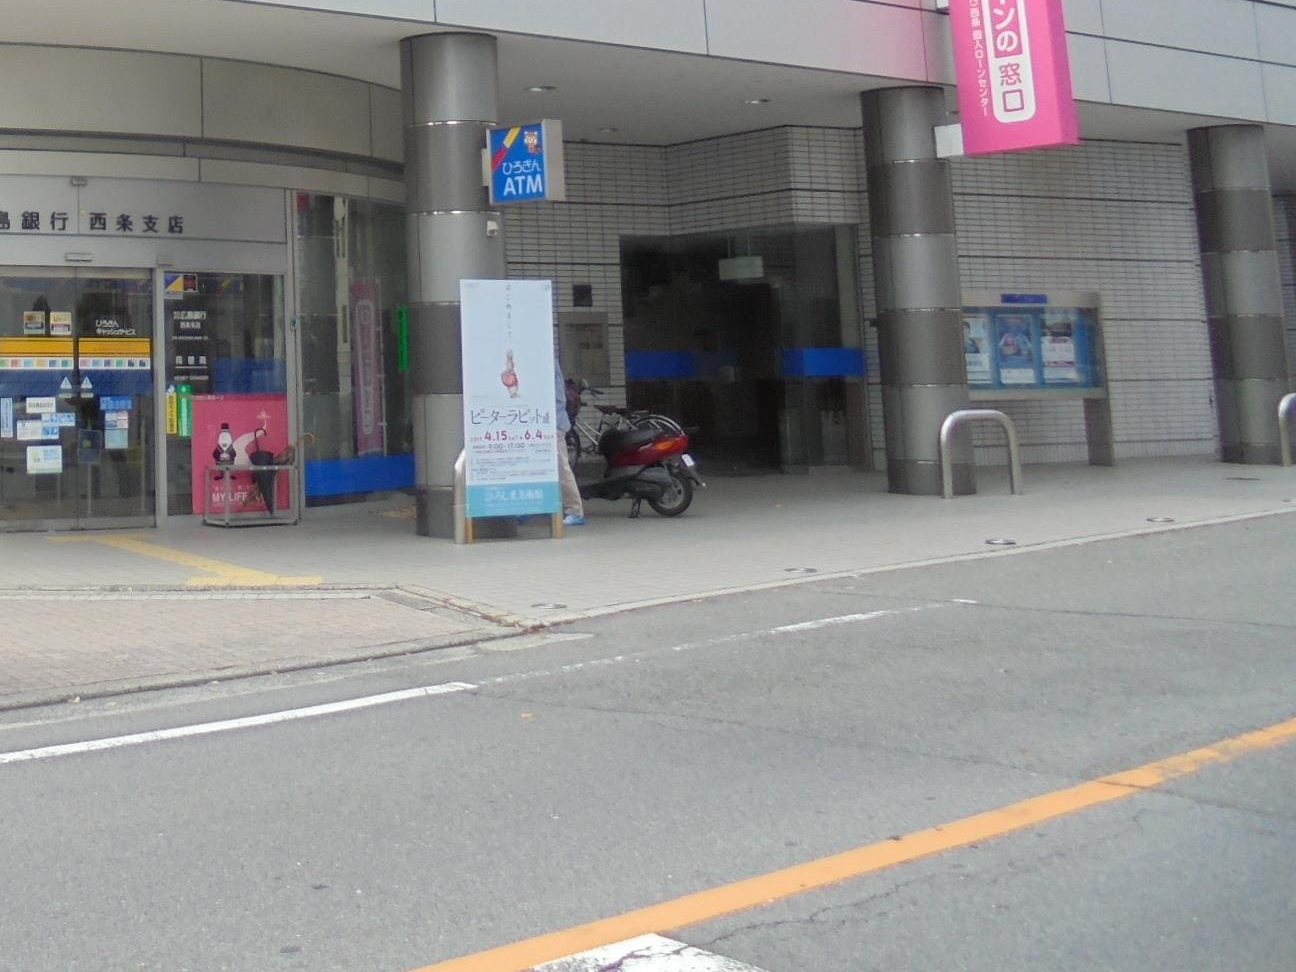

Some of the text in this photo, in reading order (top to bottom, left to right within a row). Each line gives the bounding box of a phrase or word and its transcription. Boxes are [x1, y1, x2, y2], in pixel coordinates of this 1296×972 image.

[502, 158, 542, 175] ひろぎん
[503, 174, 543, 196] ATM
[89, 211, 184, 234] 西条支店
[212, 492, 225, 502] MY
